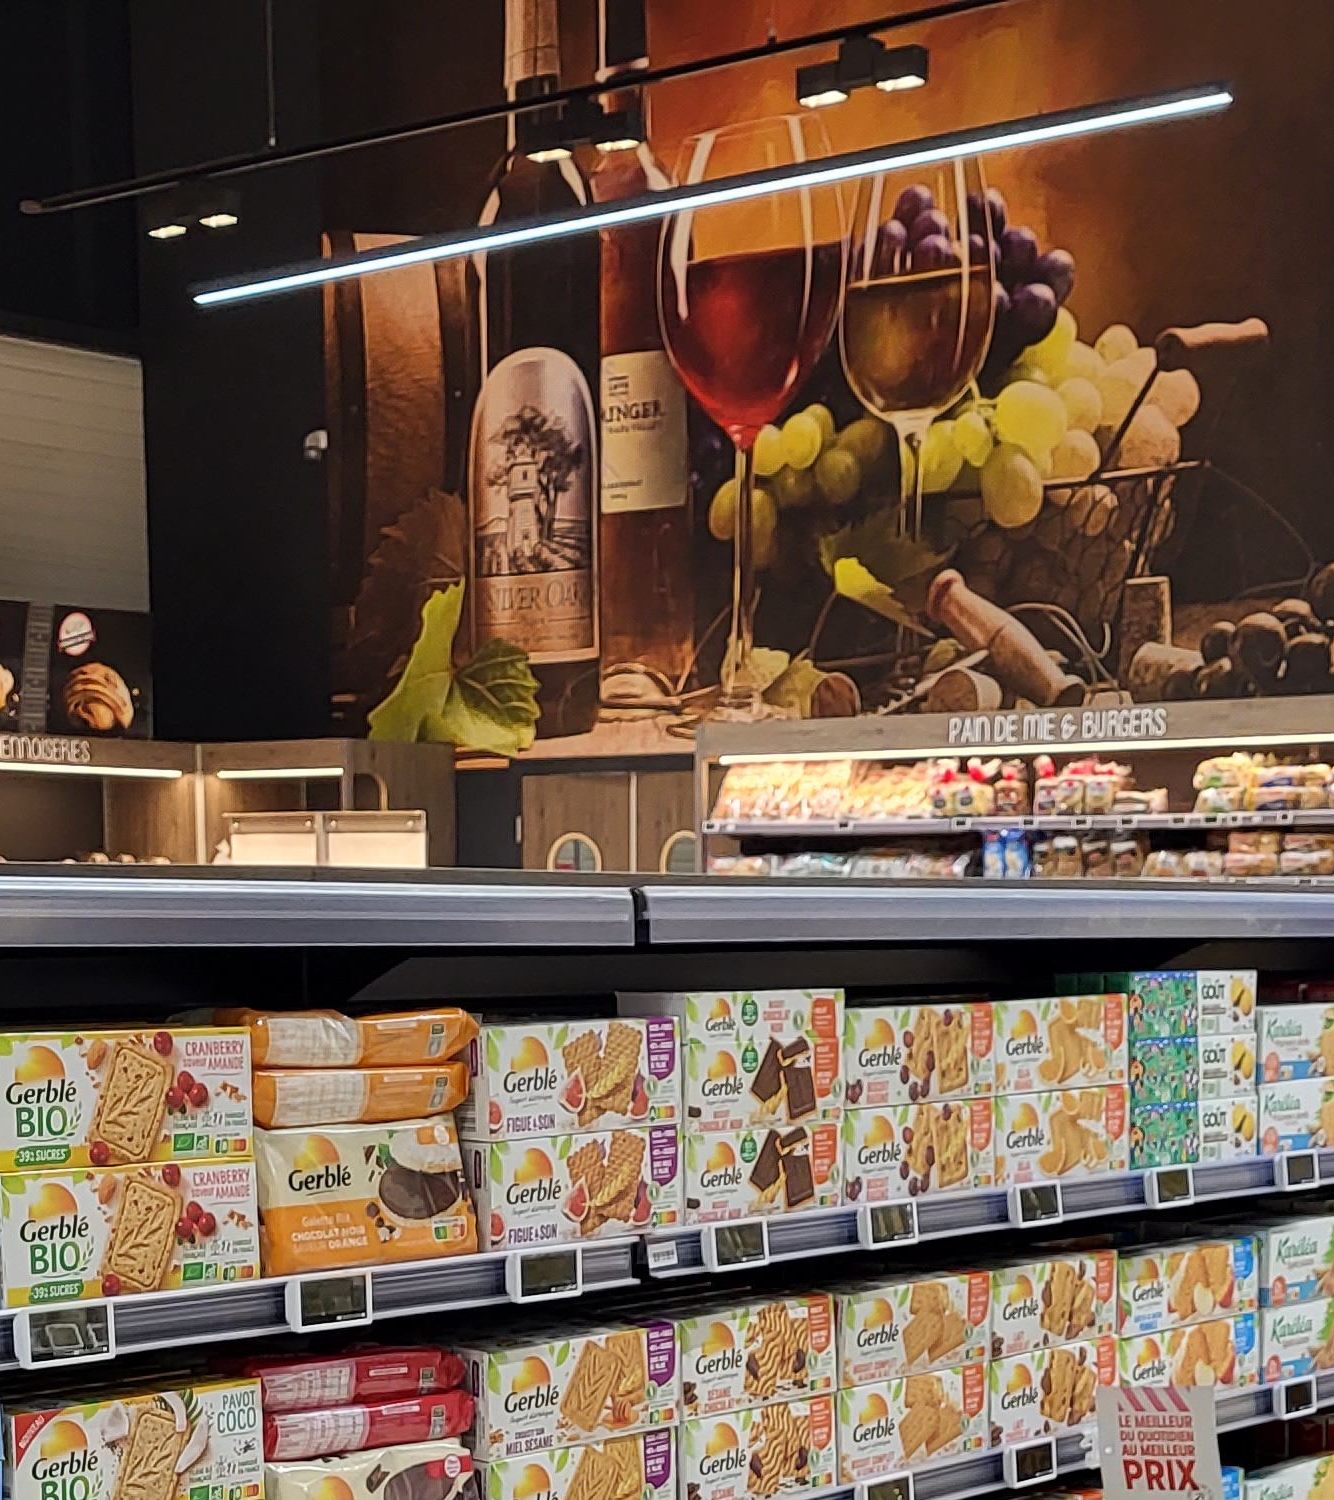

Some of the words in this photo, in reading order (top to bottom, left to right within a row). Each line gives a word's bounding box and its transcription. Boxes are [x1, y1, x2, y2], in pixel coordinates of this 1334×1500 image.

[992, 714, 1017, 739] DE
[1082, 708, 1166, 737] BURGERS
[185, 1040, 244, 1058] CRANBERRY
[5, 1081, 77, 1106] Gerblé
[503, 1071, 557, 1096] Gerblé
[15, 1108, 67, 1139] BIO
[192, 1169, 250, 1187] CRANBERRY
[506, 1181, 562, 1204] Gerblé
[19, 1217, 90, 1243] Gerblé
[29, 1244, 80, 1275] BIO
[696, 1352, 744, 1376] Gerblé
[221, 1393, 255, 1412] PAVOT
[504, 1389, 559, 1416] Gerblé
[217, 1409, 256, 1434] COCO
[1119, 1416, 1132, 1427] LE
[1135, 1416, 1192, 1427] MEILLEUR
[1121, 1431, 1134, 1441] DU
[1122, 1445, 1137, 1456] AU
[1141, 1445, 1195, 1456] MEILLEUR
[1123, 1459, 1199, 1490] PRIX
